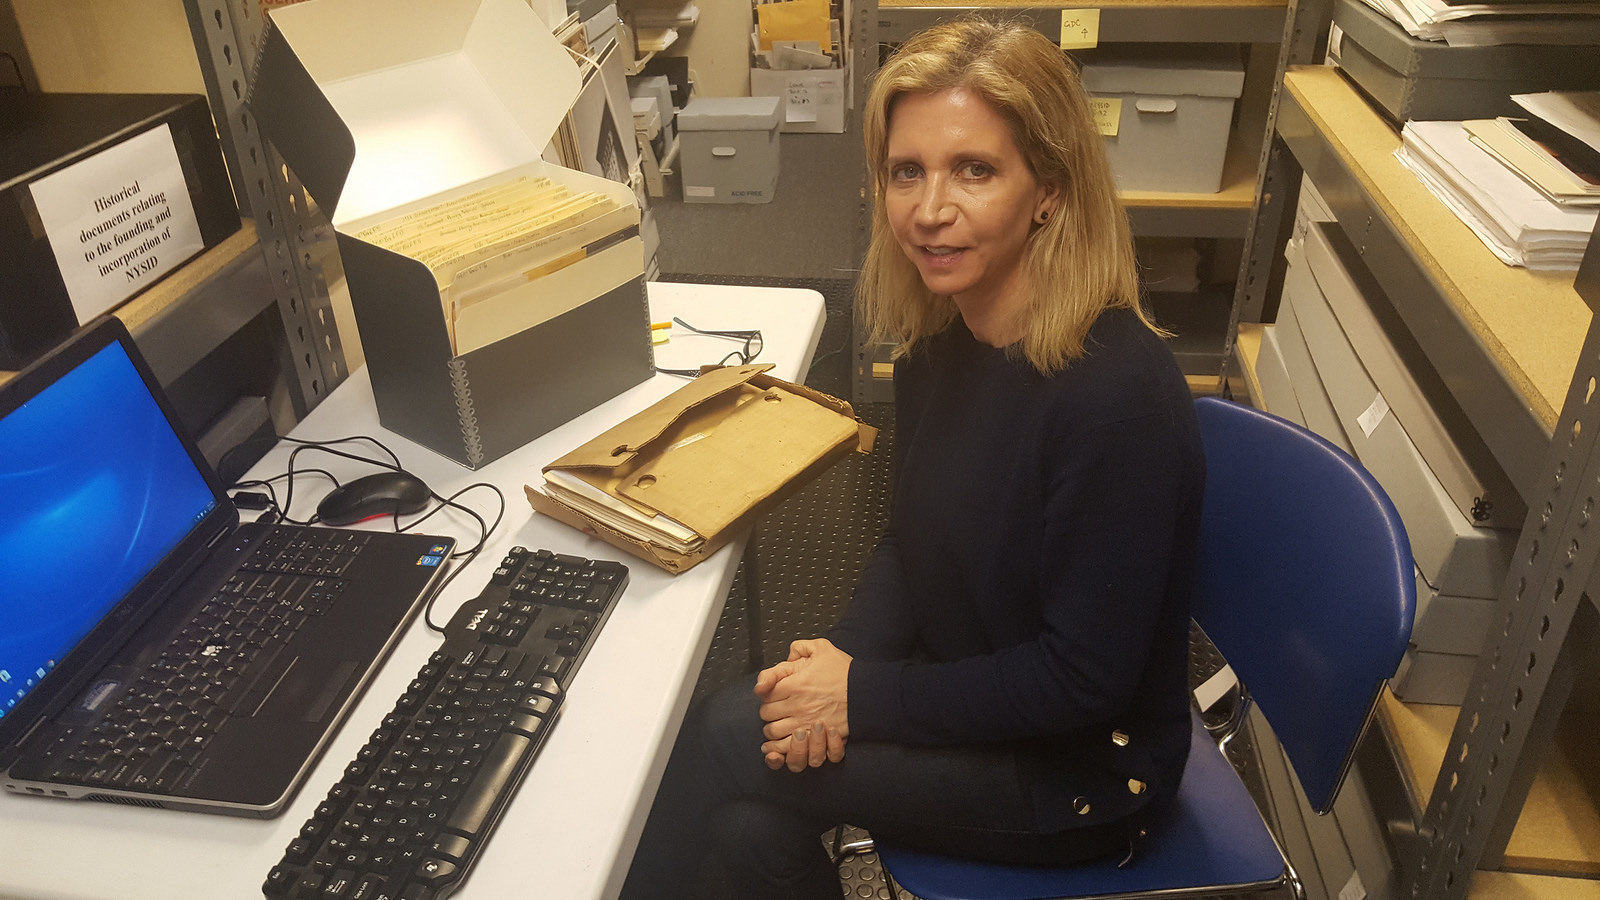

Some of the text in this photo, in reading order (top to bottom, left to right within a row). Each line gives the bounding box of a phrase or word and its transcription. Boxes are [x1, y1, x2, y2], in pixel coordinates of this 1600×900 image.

[1063, 19, 1080, 28] GDC
[94, 180, 140, 213] Historical
[80, 192, 166, 243] documents relating
[84, 206, 171, 262] to the founding and
[98, 227, 171, 277] incorporation of
[125, 255, 158, 283] NYSID
[465, 608, 489, 631] DELL
